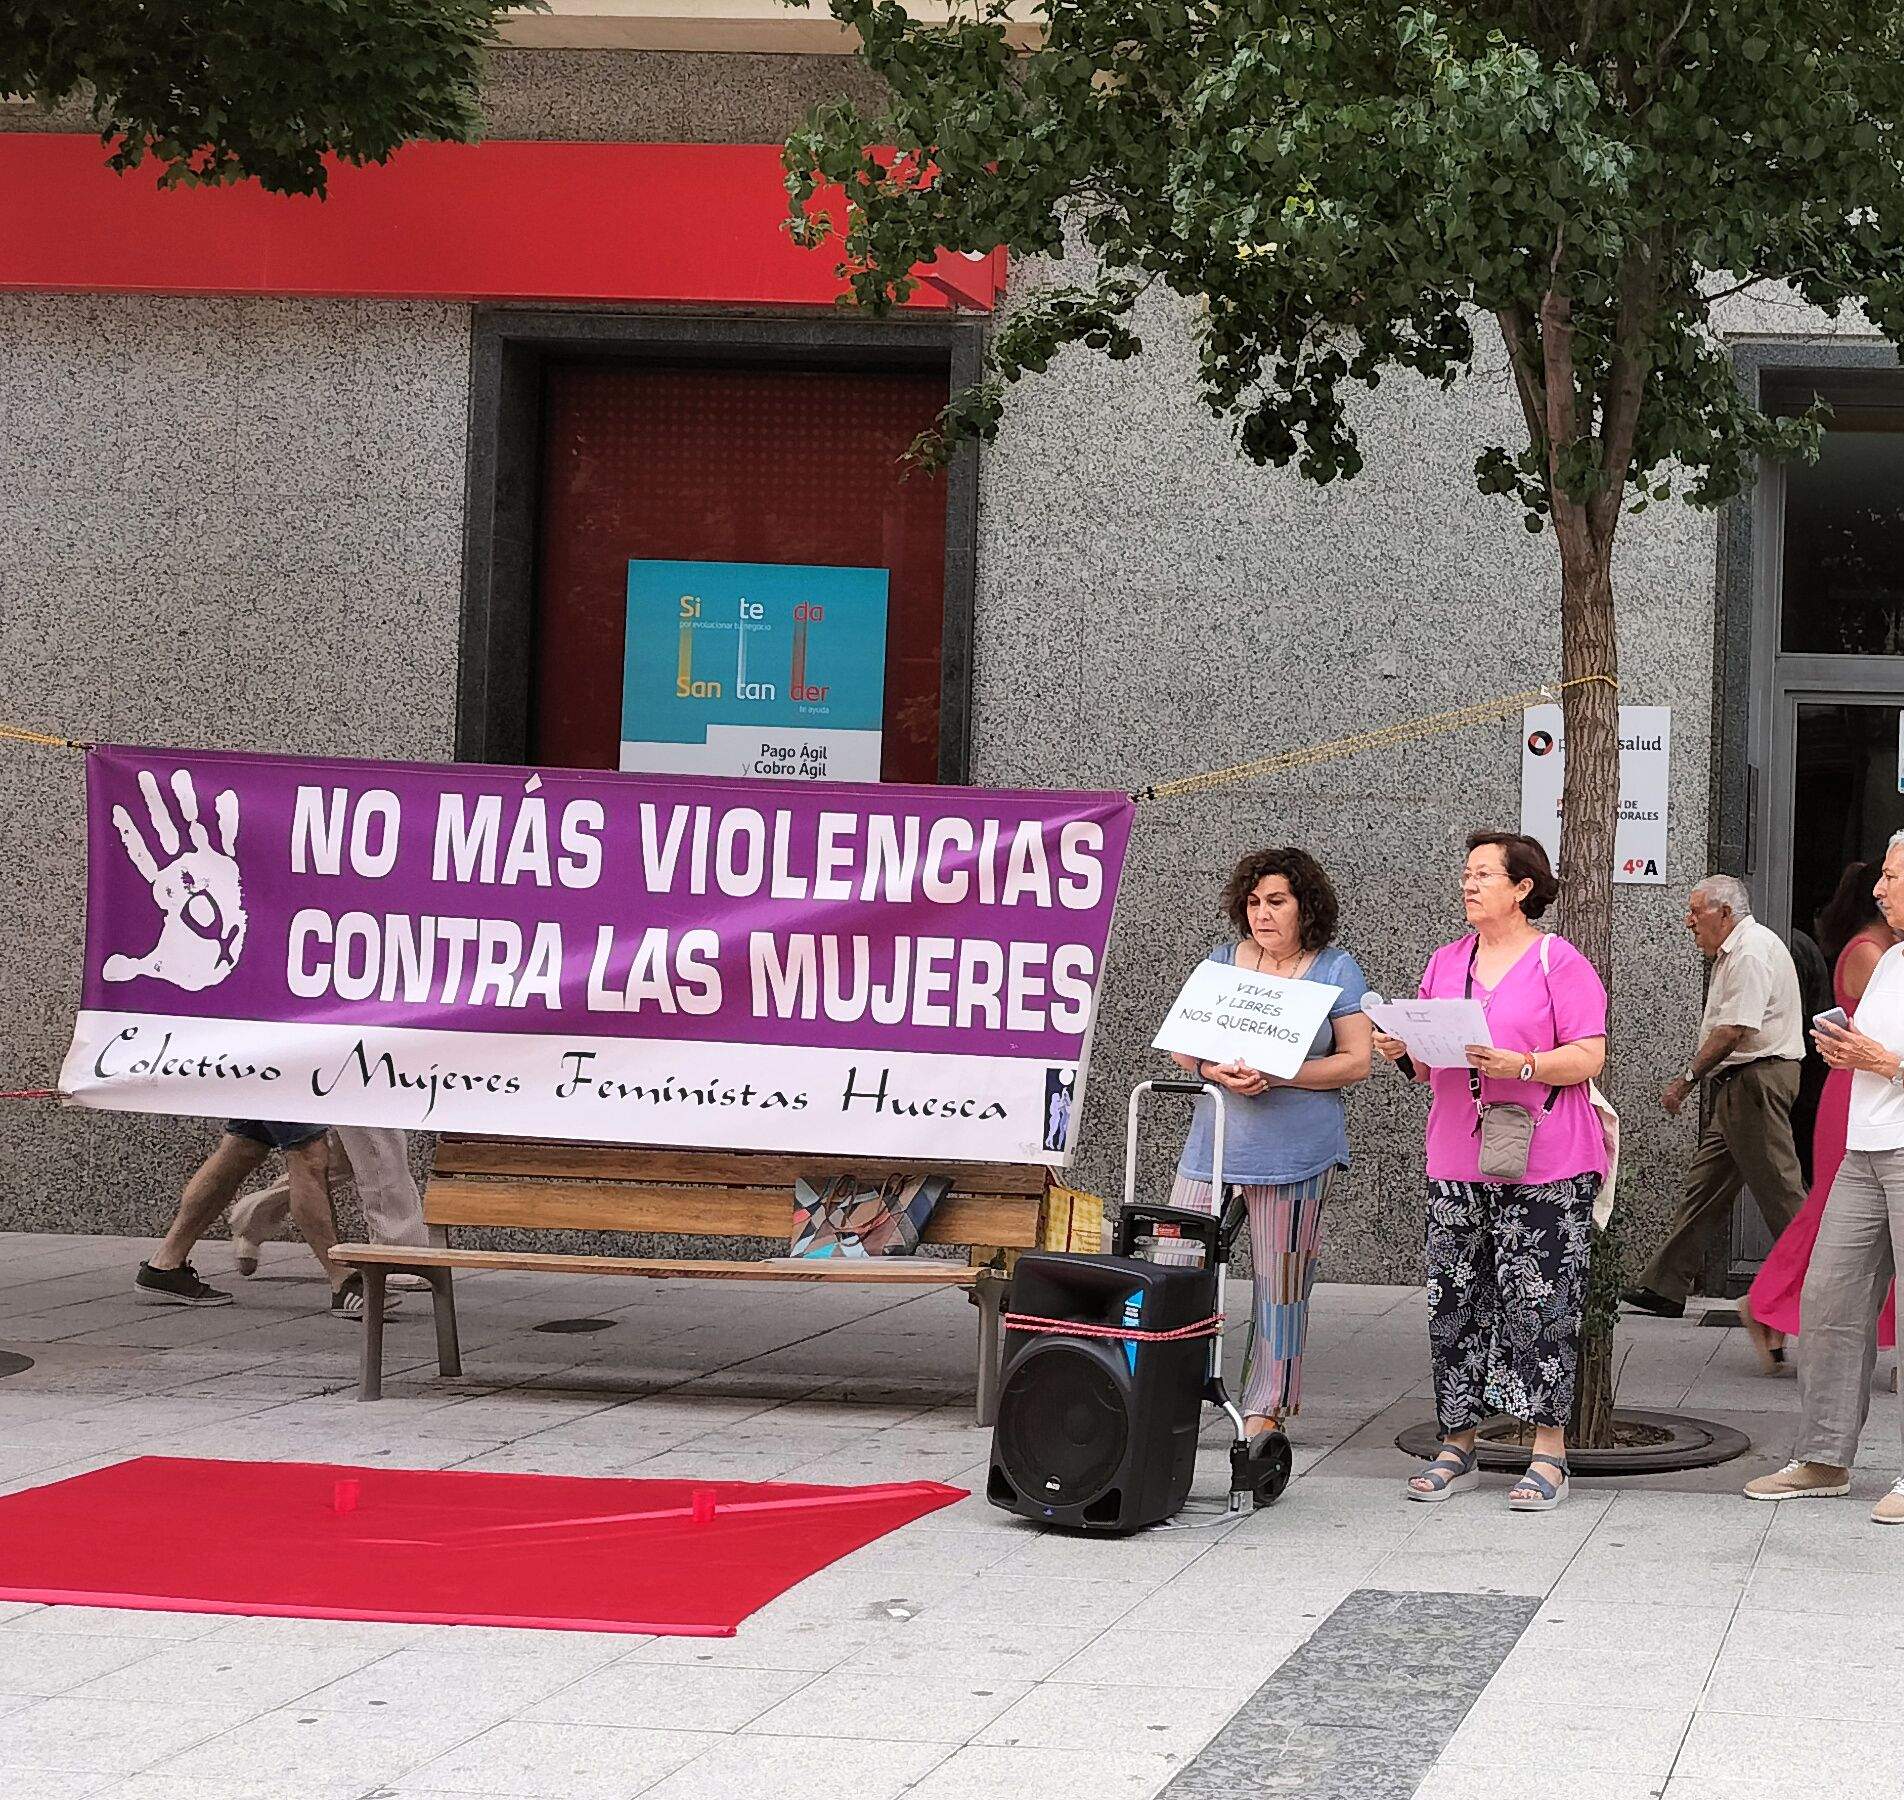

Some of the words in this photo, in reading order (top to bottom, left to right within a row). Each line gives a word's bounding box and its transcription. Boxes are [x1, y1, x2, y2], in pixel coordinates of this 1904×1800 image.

[679, 595, 701, 618] Si
[739, 597, 764, 620] te
[793, 601, 825, 622] da
[679, 621, 691, 629] por
[692, 622, 733, 630] evolucionar
[744, 623, 772, 632] negocio
[676, 676, 722, 698] San
[736, 676, 776, 700] tan
[760, 743, 796, 761] Pago
[800, 742, 828, 762] Ágil
[742, 762, 750, 776] y
[754, 760, 796, 777] Cobro
[799, 759, 827, 779] Ágil
[1624, 801, 1638, 809] DE
[291, 786, 400, 878] NO
[432, 773, 605, 889] MÁS
[640, 803, 1104, 910] VIOLENCIAS
[286, 908, 562, 1010] CONTRA
[587, 925, 722, 1015] LAS
[750, 931, 1094, 1033] MUJERES
[1236, 982, 1284, 1000] VIVAS
[1216, 995, 1226, 1005] Y
[1228, 996, 1283, 1017] LIBRES
[1179, 1007, 1213, 1024] NOS
[1216, 1013, 1300, 1044] QUEREMOS
[94, 1026, 282, 1081] Colectivo
[311, 1039, 521, 1122] Mujeres
[556, 1051, 809, 1111] Feministas
[841, 1067, 1008, 1121] Huesca
